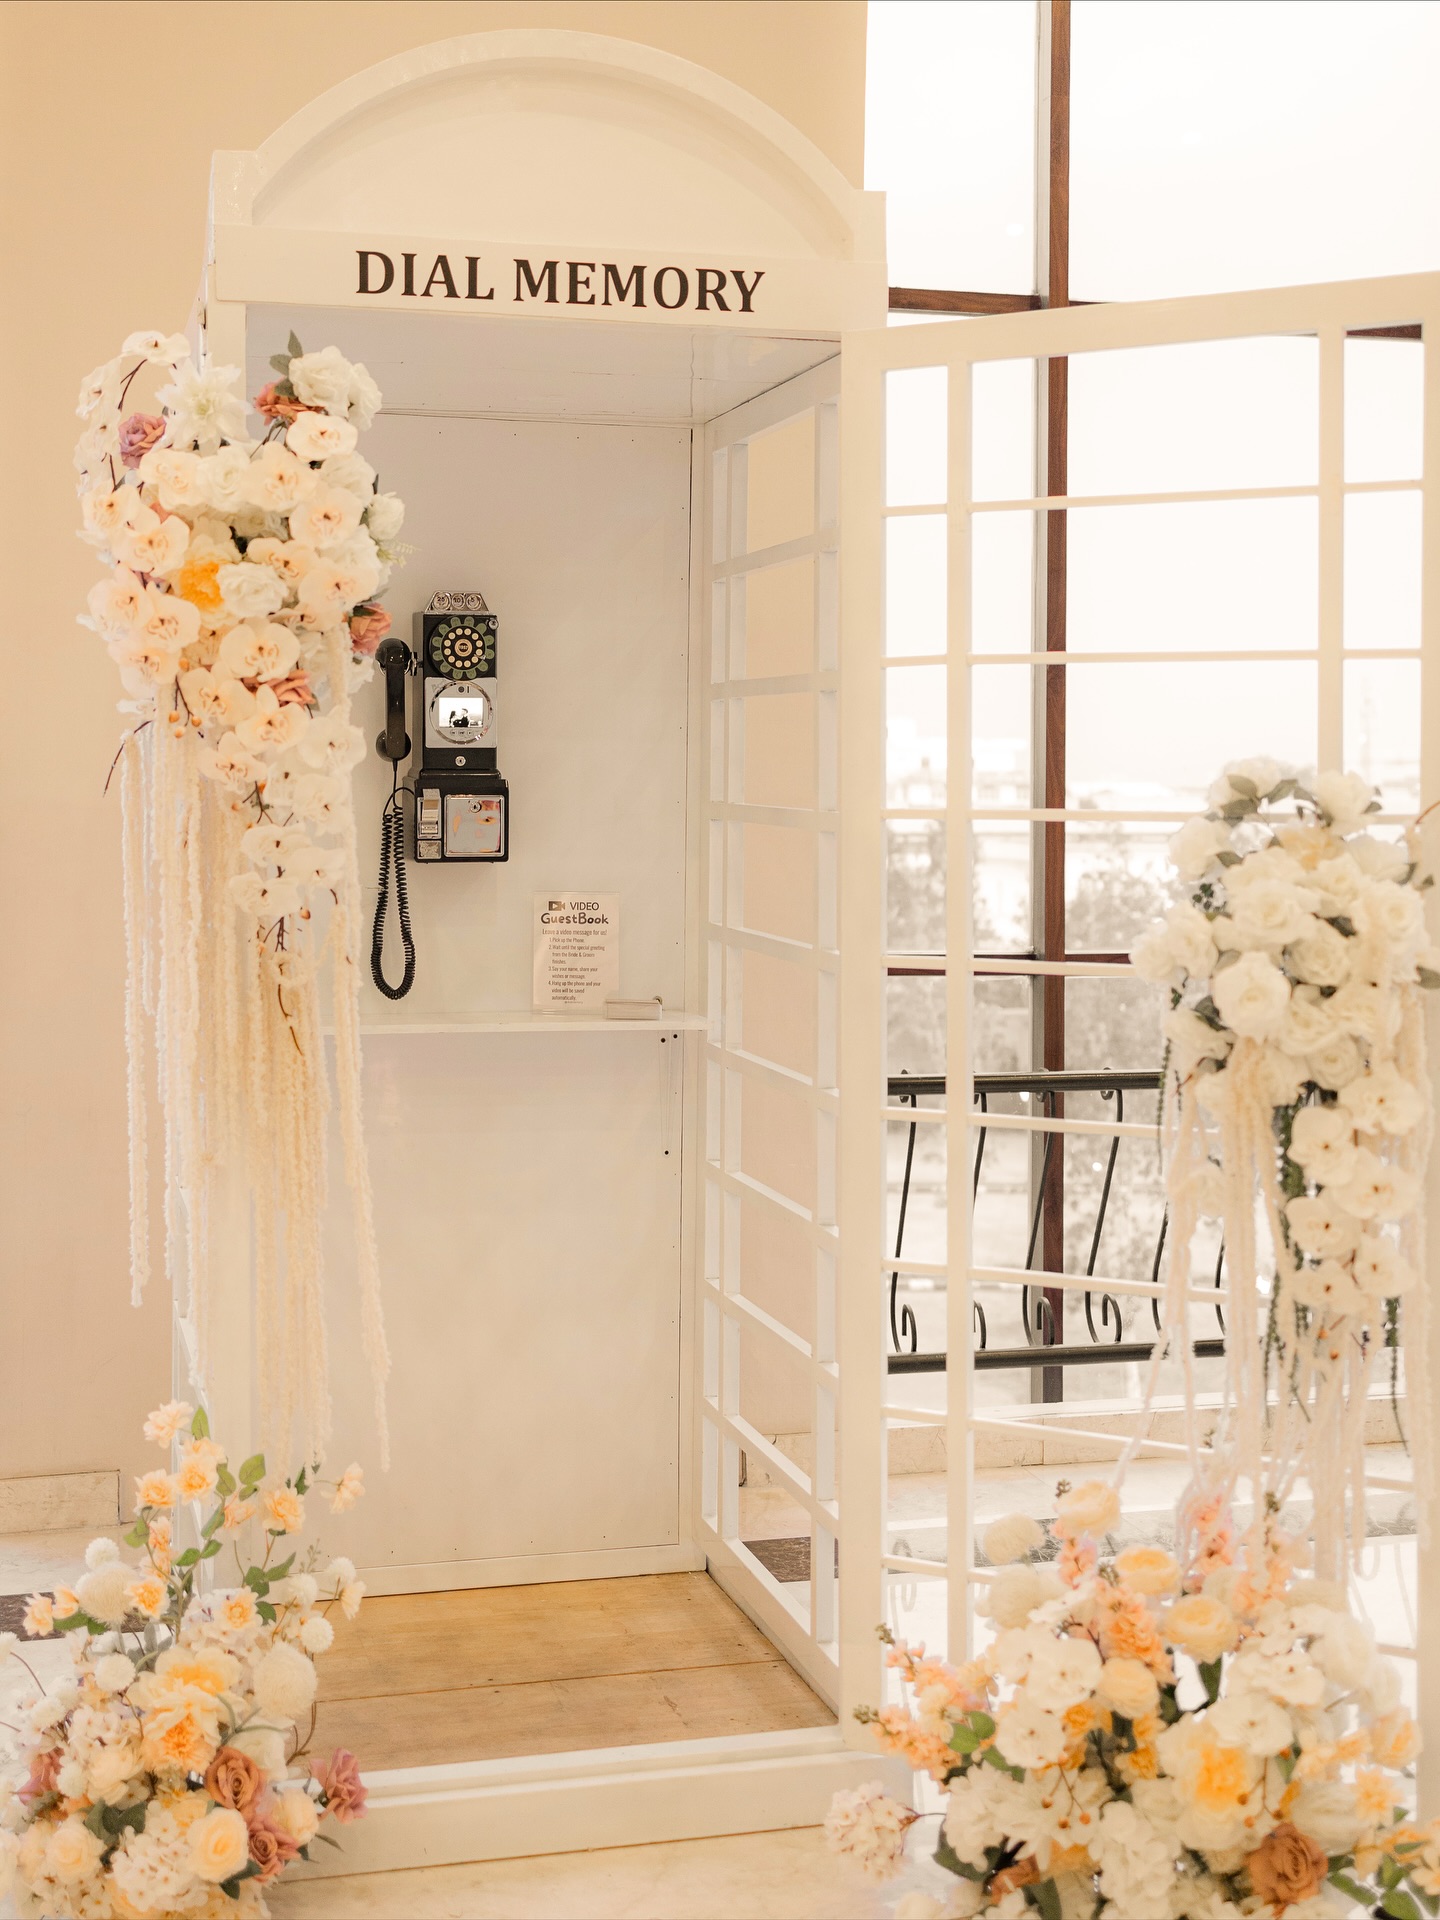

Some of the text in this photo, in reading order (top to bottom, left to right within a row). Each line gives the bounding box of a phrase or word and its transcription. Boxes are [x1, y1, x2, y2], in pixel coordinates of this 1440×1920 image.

[355, 250, 766, 313] DIAL MEMORY
[570, 902, 600, 910] VIDEO
[540, 912, 609, 924] GuestBook
